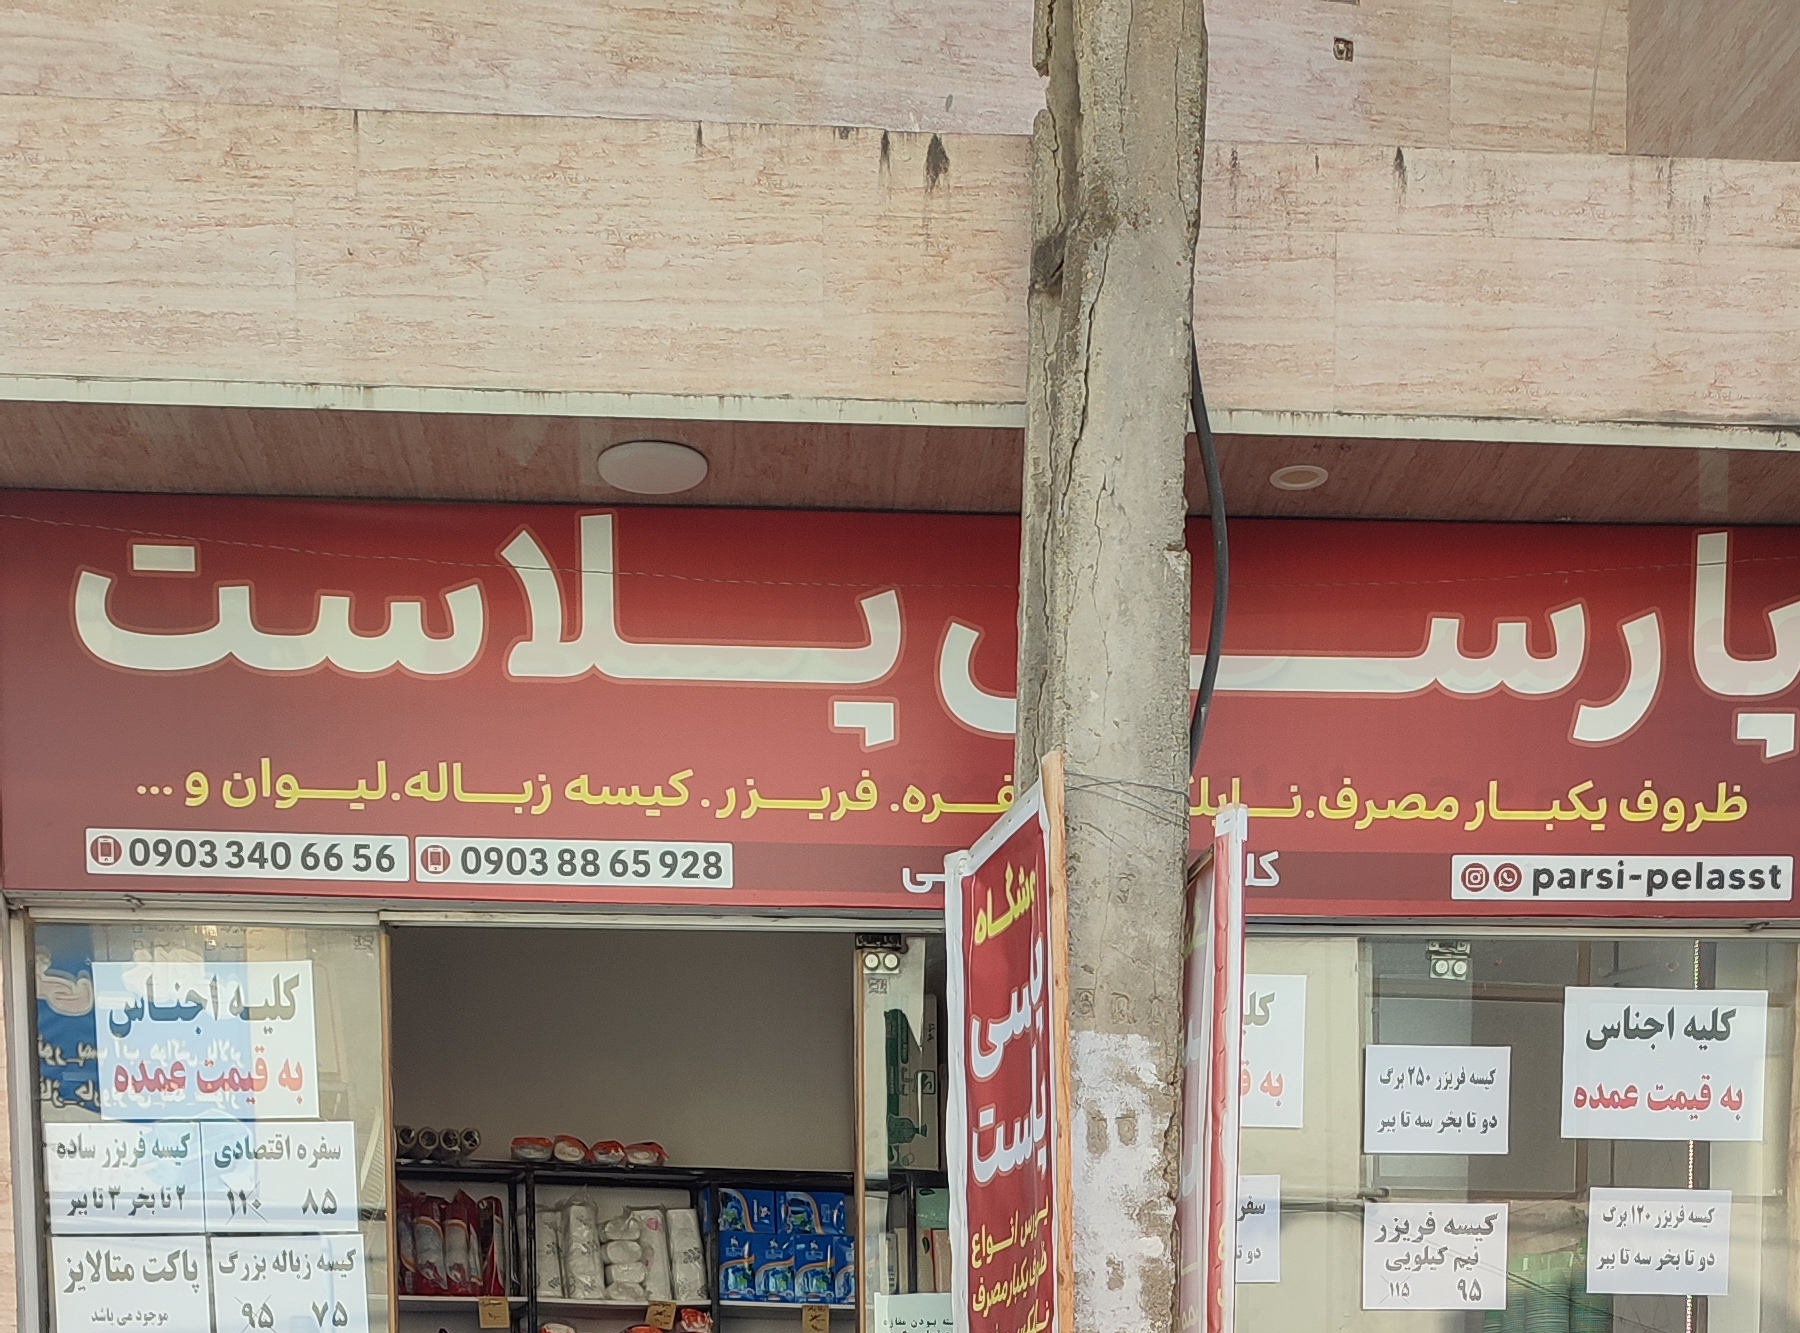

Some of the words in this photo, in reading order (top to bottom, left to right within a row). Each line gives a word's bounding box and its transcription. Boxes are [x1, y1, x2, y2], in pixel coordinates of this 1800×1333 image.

[75, 512, 905, 747] پلاست
[185, 771, 209, 806] و
[221, 757, 387, 810] لیوان
[564, 769, 693, 816] کیسه
[1464, 780, 1607, 831] یکبار
[1619, 780, 1748, 832] ظروف
[129, 837, 218, 868] 0903
[225, 840, 291, 870] 340
[300, 842, 343, 872] 66
[352, 843, 395, 873] 56
[461, 846, 548, 876] 0903
[557, 848, 600, 878] 88
[609, 849, 651, 879] 65
[659, 850, 723, 880] 928
[1532, 860, 1782, 897] parsi-pelasst
[110, 973, 219, 1038] اجناس
[229, 973, 299, 1034] کلیه
[1586, 1005, 1674, 1050] اجناس
[1684, 1007, 1736, 1050] کلیه
[115, 1060, 186, 1093] عمده
[197, 1046, 267, 1104] قیمت
[278, 1059, 303, 1104] به
[1260, 1071, 1285, 1107] به
[1379, 1067, 1404, 1089] برگ
[1408, 1066, 1431, 1086] ۲۵۰
[1436, 1066, 1465, 1090] فریزر
[1469, 1068, 1496, 1089] کیسه
[1574, 1083, 1638, 1109] عمده
[1648, 1075, 1712, 1120] قیمت
[1720, 1084, 1742, 1120] به
[1400, 1111, 1411, 1127] تا
[1415, 1114, 1433, 1127] سه
[1437, 1111, 1462, 1133] بخر
[1467, 1111, 1477, 1128] تا
[1480, 1114, 1498, 1134] دو
[56, 1132, 95, 1160] ساده
[102, 1130, 146, 1168] فریزر
[152, 1133, 190, 1165] کیسه
[214, 1133, 291, 1168] اقتصادی
[296, 1135, 341, 1168] سفره
[92, 1188, 103, 1209] تا
[128, 1186, 155, 1216] بخر
[161, 1187, 172, 1208] تا
[302, 1188, 338, 1215] ۸۵
[1374, 1211, 1435, 1242] فریزر
[1444, 1213, 1498, 1241] کیسه
[1603, 1206, 1627, 1227] برگ
[1632, 1204, 1650, 1224] ۱۲۰
[1655, 1205, 1685, 1228] فریزر
[1688, 1208, 1715, 1227] کیسه
[219, 1251, 266, 1281] بزرگ
[272, 1250, 311, 1280] زباله
[317, 1249, 357, 1278] کیسه
[1246, 1247, 1261, 1264] دو
[1386, 1246, 1448, 1271] کیلویی
[1454, 1246, 1478, 1271] نیم
[1620, 1248, 1631, 1265] تا
[1634, 1252, 1651, 1265] سه
[1655, 1249, 1680, 1270] بخر
[1685, 1249, 1695, 1265] تا
[1698, 1252, 1715, 1271] دو
[63, 1250, 135, 1293] متالایز
[143, 1249, 200, 1293] پاکت
[973, 1277, 1008, 1317] مصرف
[1390, 1281, 1410, 1297] ۱۱۵
[1457, 1278, 1482, 1301] ۹۵
[92, 1307, 113, 1325] باشد
[136, 1308, 168, 1326] موجود
[241, 1302, 274, 1329] ۹۵
[312, 1301, 348, 1328] ۷۵
